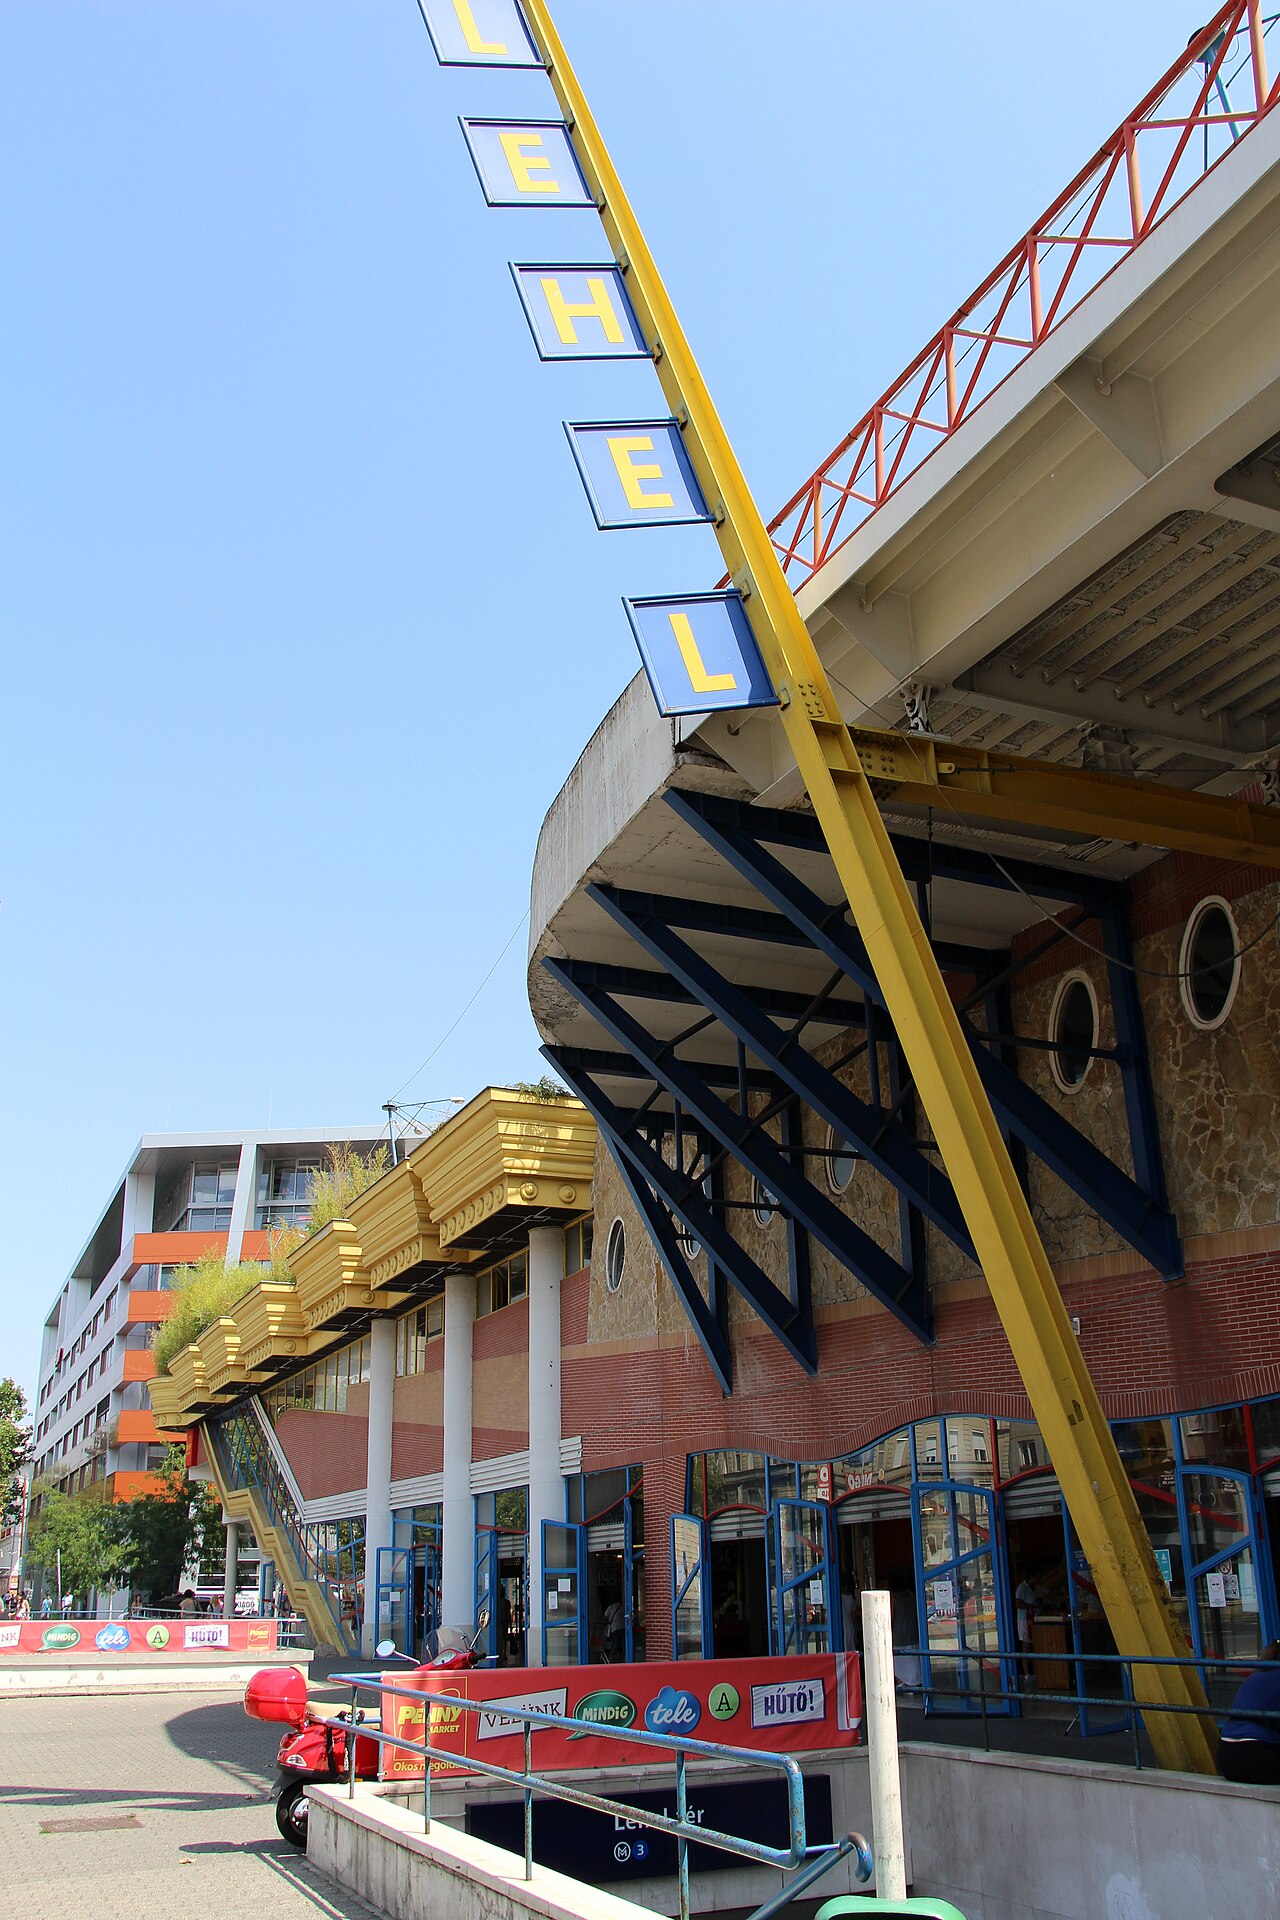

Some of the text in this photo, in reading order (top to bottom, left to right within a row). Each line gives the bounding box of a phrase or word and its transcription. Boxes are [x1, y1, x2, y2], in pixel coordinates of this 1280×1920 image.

[99, 1629, 129, 1645] tele
[151, 1630, 165, 1644] A
[649, 1696, 697, 1725] tele
[714, 1692, 734, 1712] A
[763, 1684, 816, 1717] HŰTŐ!
[397, 1705, 463, 1725] PENNY
[393, 1761, 419, 1772] Okos
[675, 1805, 706, 1824] ér
